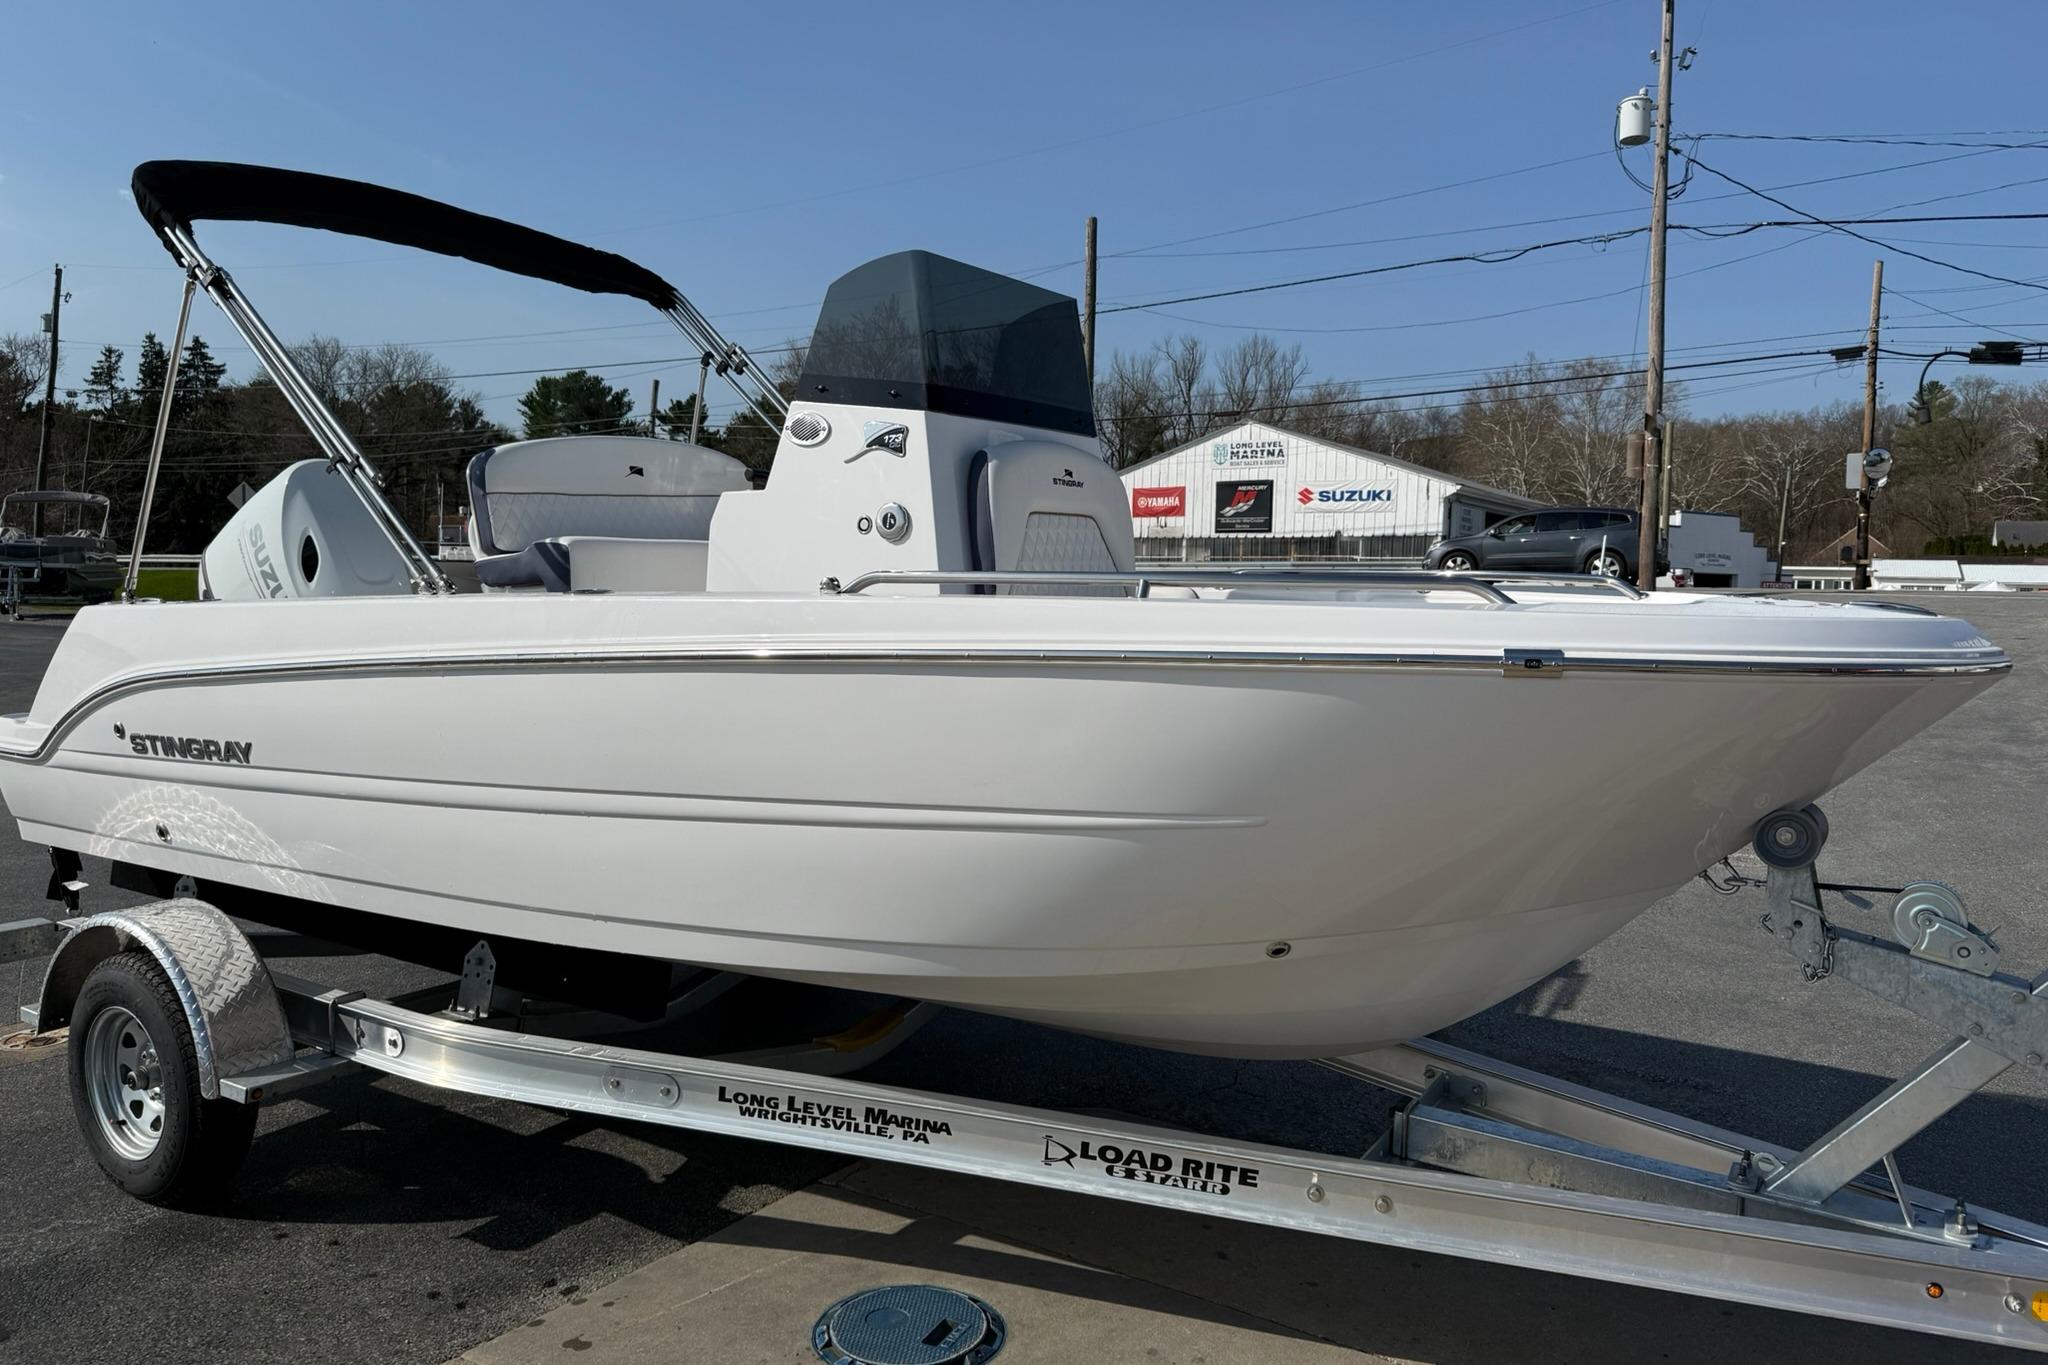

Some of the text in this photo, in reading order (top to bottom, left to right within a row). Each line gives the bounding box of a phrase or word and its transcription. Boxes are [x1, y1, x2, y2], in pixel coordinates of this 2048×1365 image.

[884, 434, 903, 443] 173
[1256, 441, 1283, 449] LEVEL
[1230, 449, 1285, 460] MARINA
[1052, 477, 1085, 488] STINGRAY
[1147, 496, 1180, 507] YAMAHA
[1318, 489, 1392, 502] SUZUKI
[130, 733, 252, 764] STINGRAY
[738, 1105, 930, 1145] WRIGHTSVILLE, PA
[1079, 1140, 1260, 1189] LOAD RITE
[1112, 1166, 1225, 1196] 5 STARR
